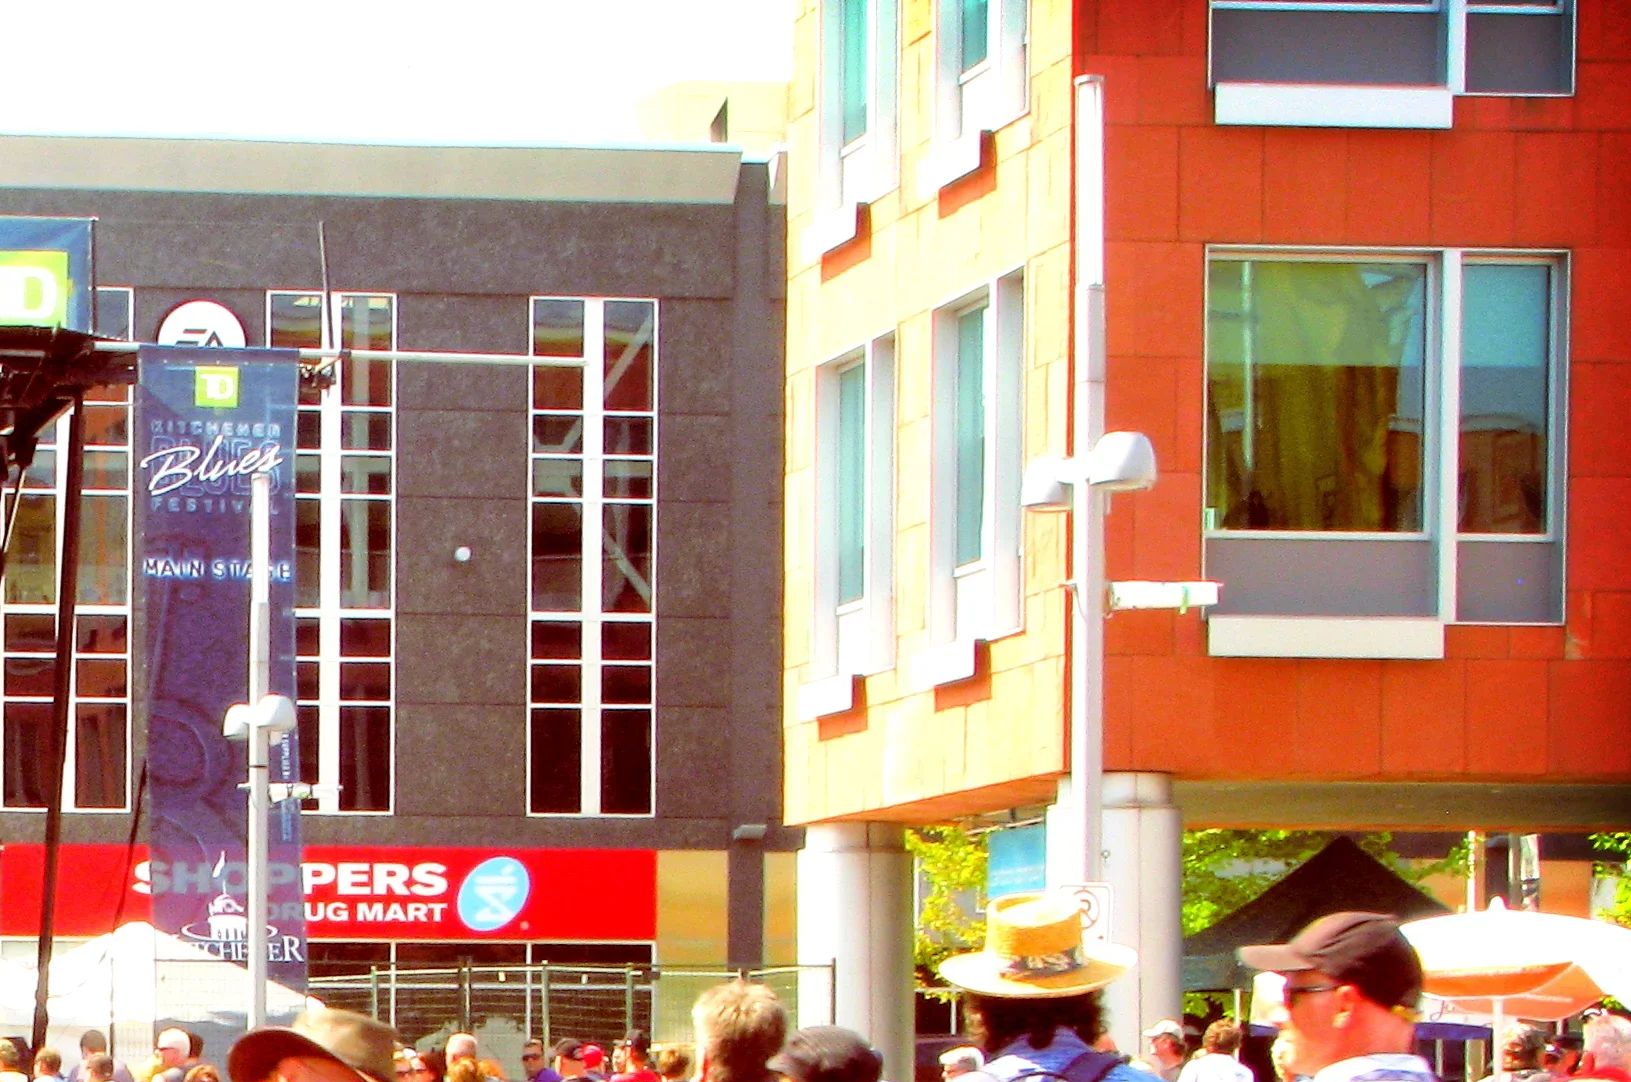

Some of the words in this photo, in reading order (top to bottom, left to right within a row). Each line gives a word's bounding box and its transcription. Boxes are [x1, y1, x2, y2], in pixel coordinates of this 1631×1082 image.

[200, 373, 235, 400] TD
[139, 434, 283, 496] Blues
[150, 497, 279, 515] FESTIVL
[144, 558, 205, 577] MAIN
[211, 560, 292, 581] STAE
[133, 861, 449, 896] SHOPPERS
[356, 902, 448, 923] MART
